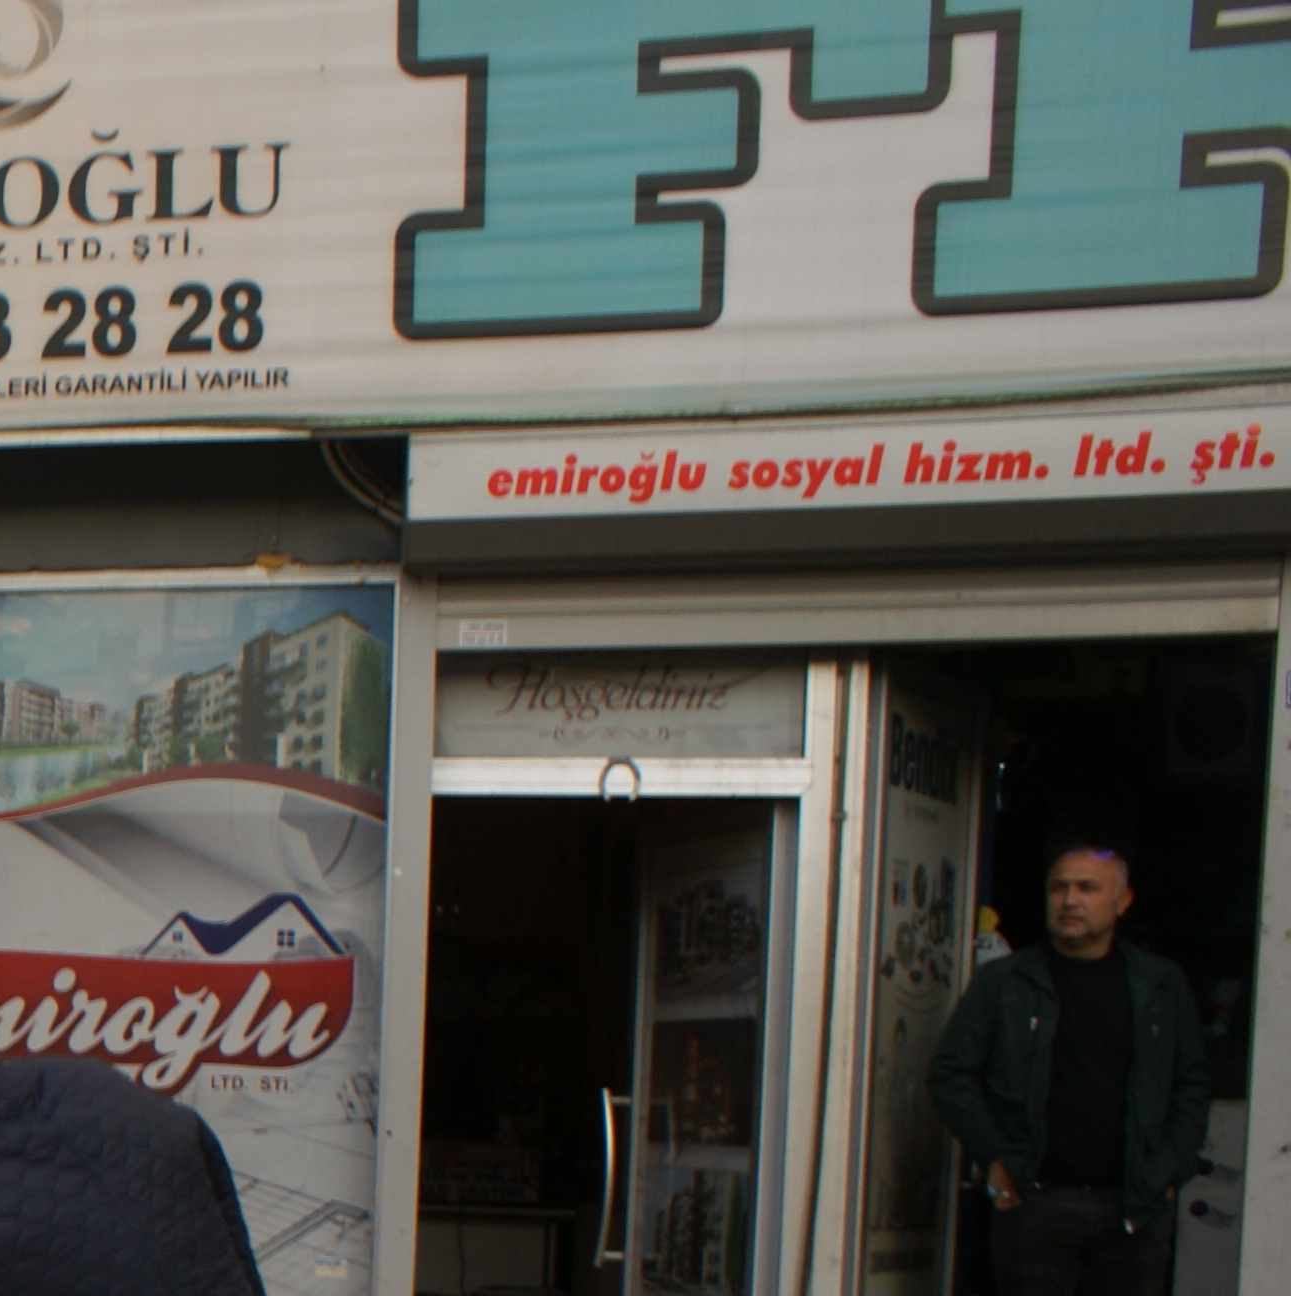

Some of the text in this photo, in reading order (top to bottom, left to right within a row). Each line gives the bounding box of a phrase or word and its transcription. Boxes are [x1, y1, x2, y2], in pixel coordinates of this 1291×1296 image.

[35, 234, 116, 264] LTD.
[131, 226, 205, 262] ŞTİ.
[40, 284, 138, 360] 28
[166, 278, 265, 355] 28
[55, 366, 188, 396] GARANTİLİ
[195, 366, 290, 391] YAPILIR
[487, 423, 1275, 503] emiroğlu sosyal hizm. ltd. şti.
[486, 661, 730, 724] Hoşgeldiniz
